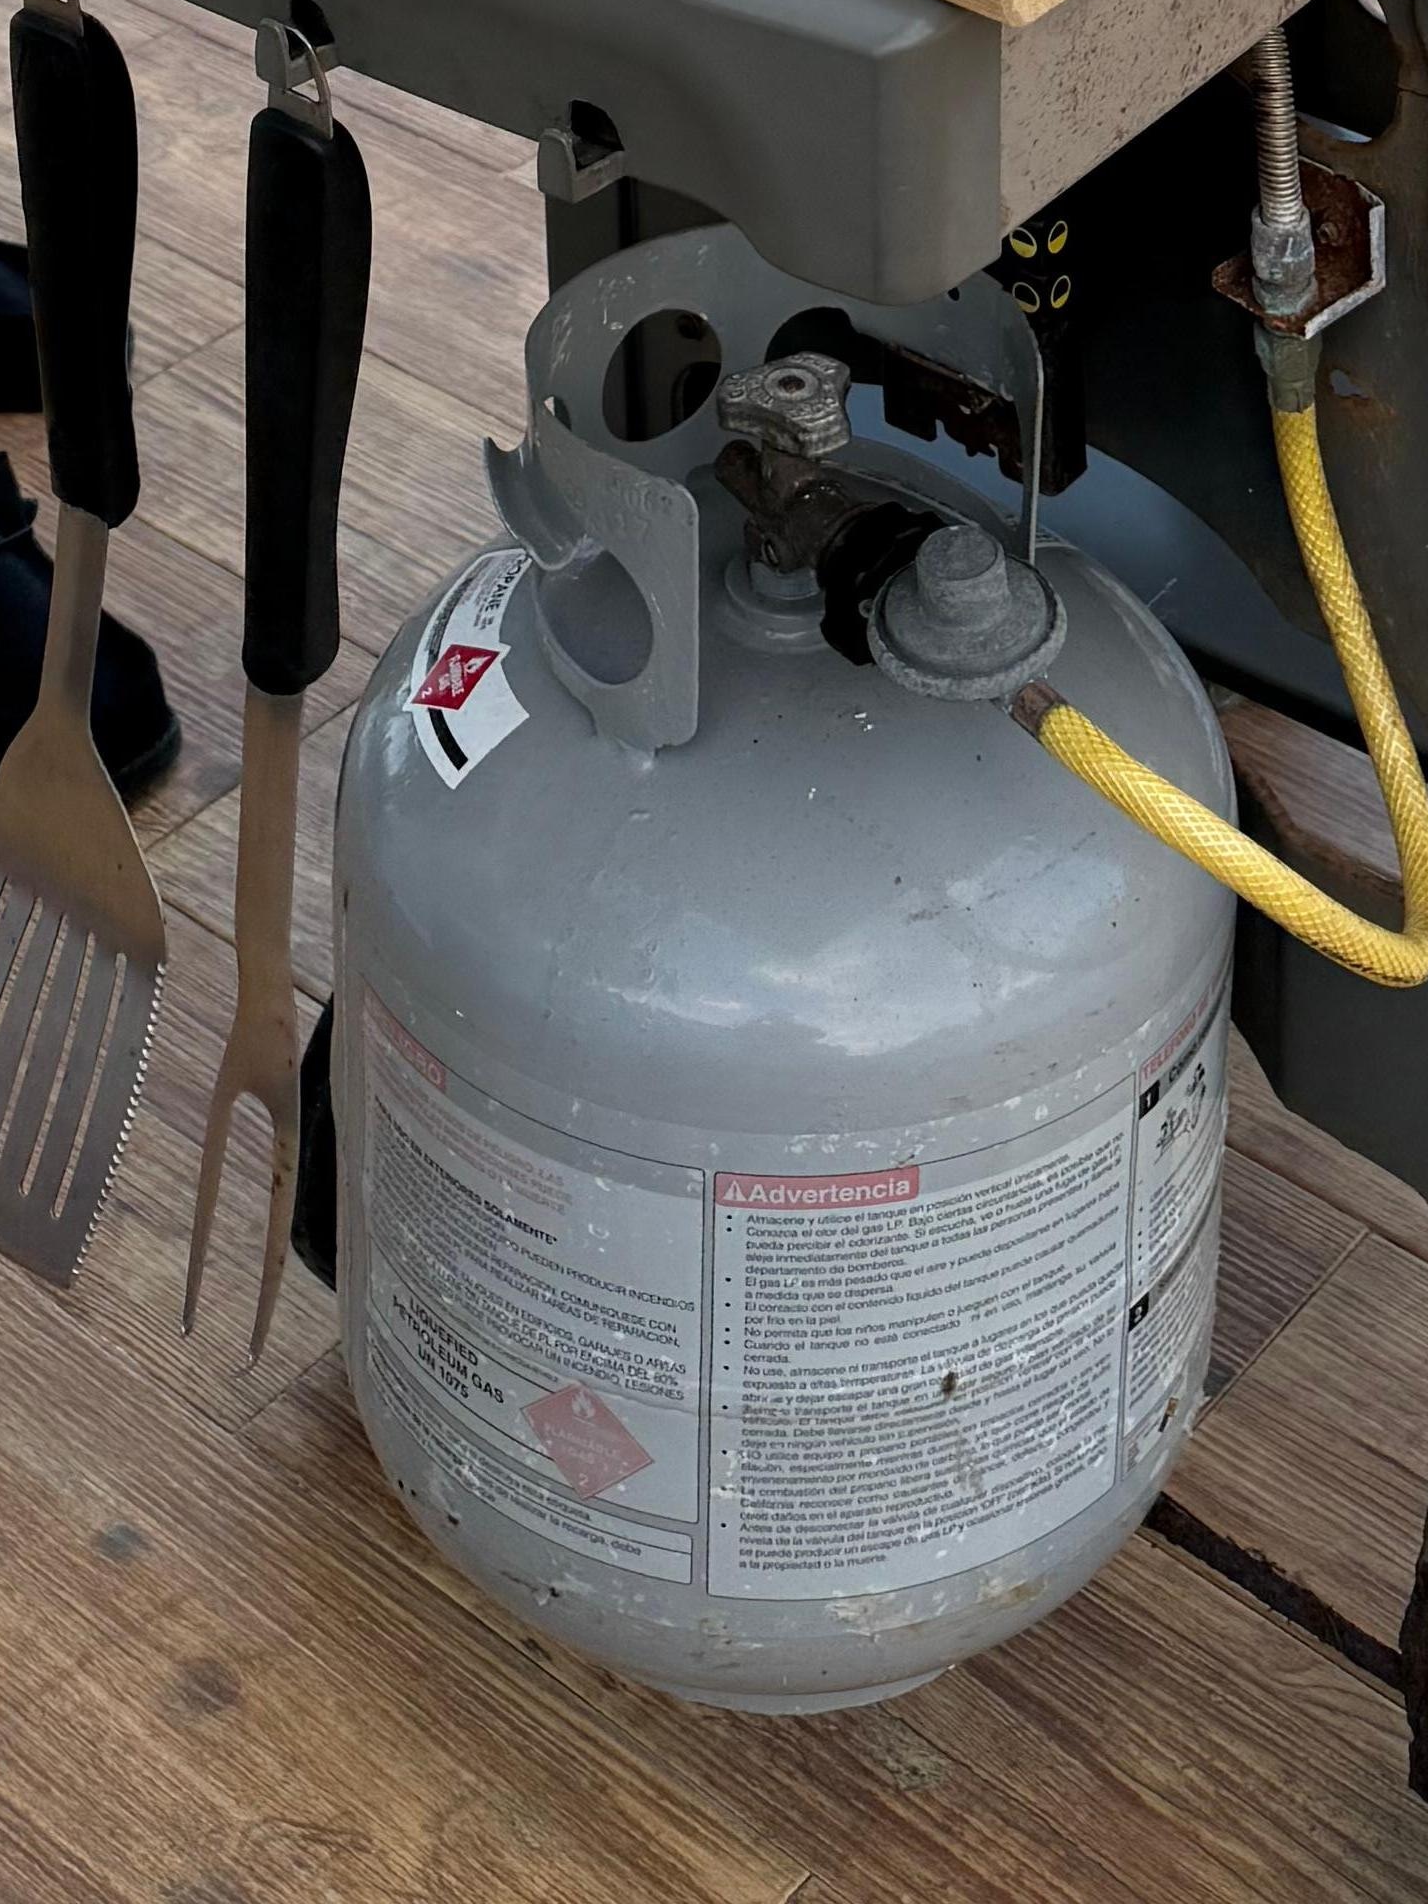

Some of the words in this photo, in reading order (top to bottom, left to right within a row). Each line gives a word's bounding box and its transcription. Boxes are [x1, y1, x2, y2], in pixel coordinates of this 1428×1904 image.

[1146, 1094, 1152, 1108] 1
[747, 1178, 910, 1204] Advertencia
[410, 1298, 478, 1366] LIQUEFIED
[648, 1318, 676, 1334] CON
[418, 1344, 436, 1371] UN
[440, 1366, 469, 1398] 1075
[472, 1373, 504, 1404] GAS
[579, 1472, 588, 1486] 2
